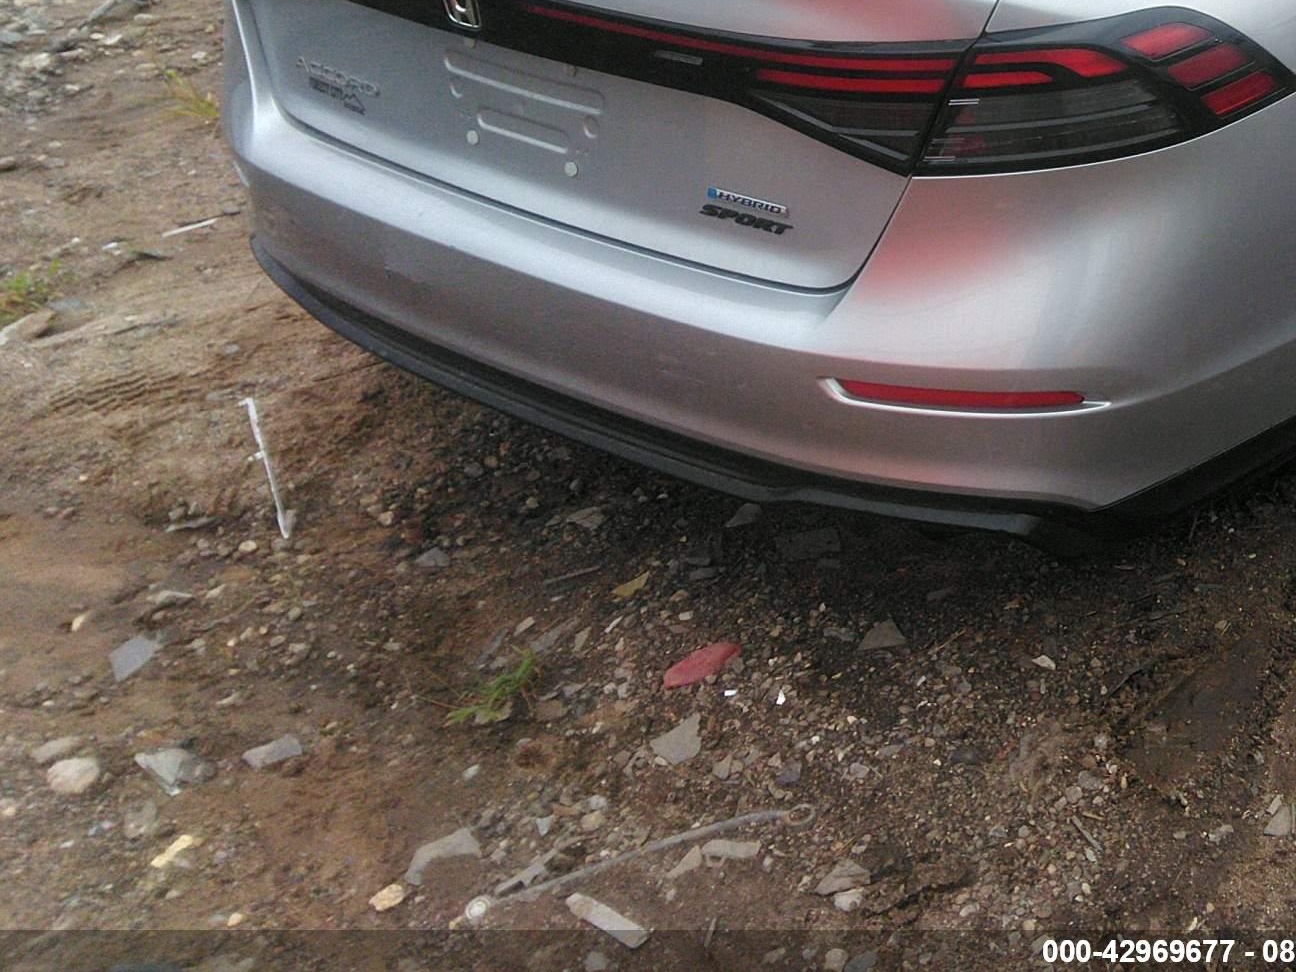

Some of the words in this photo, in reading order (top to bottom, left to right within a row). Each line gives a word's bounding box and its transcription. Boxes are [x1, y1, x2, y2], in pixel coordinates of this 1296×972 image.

[296, 56, 380, 97] ACCORD
[719, 191, 783, 214] HYBRID
[699, 203, 795, 235] SPORT
